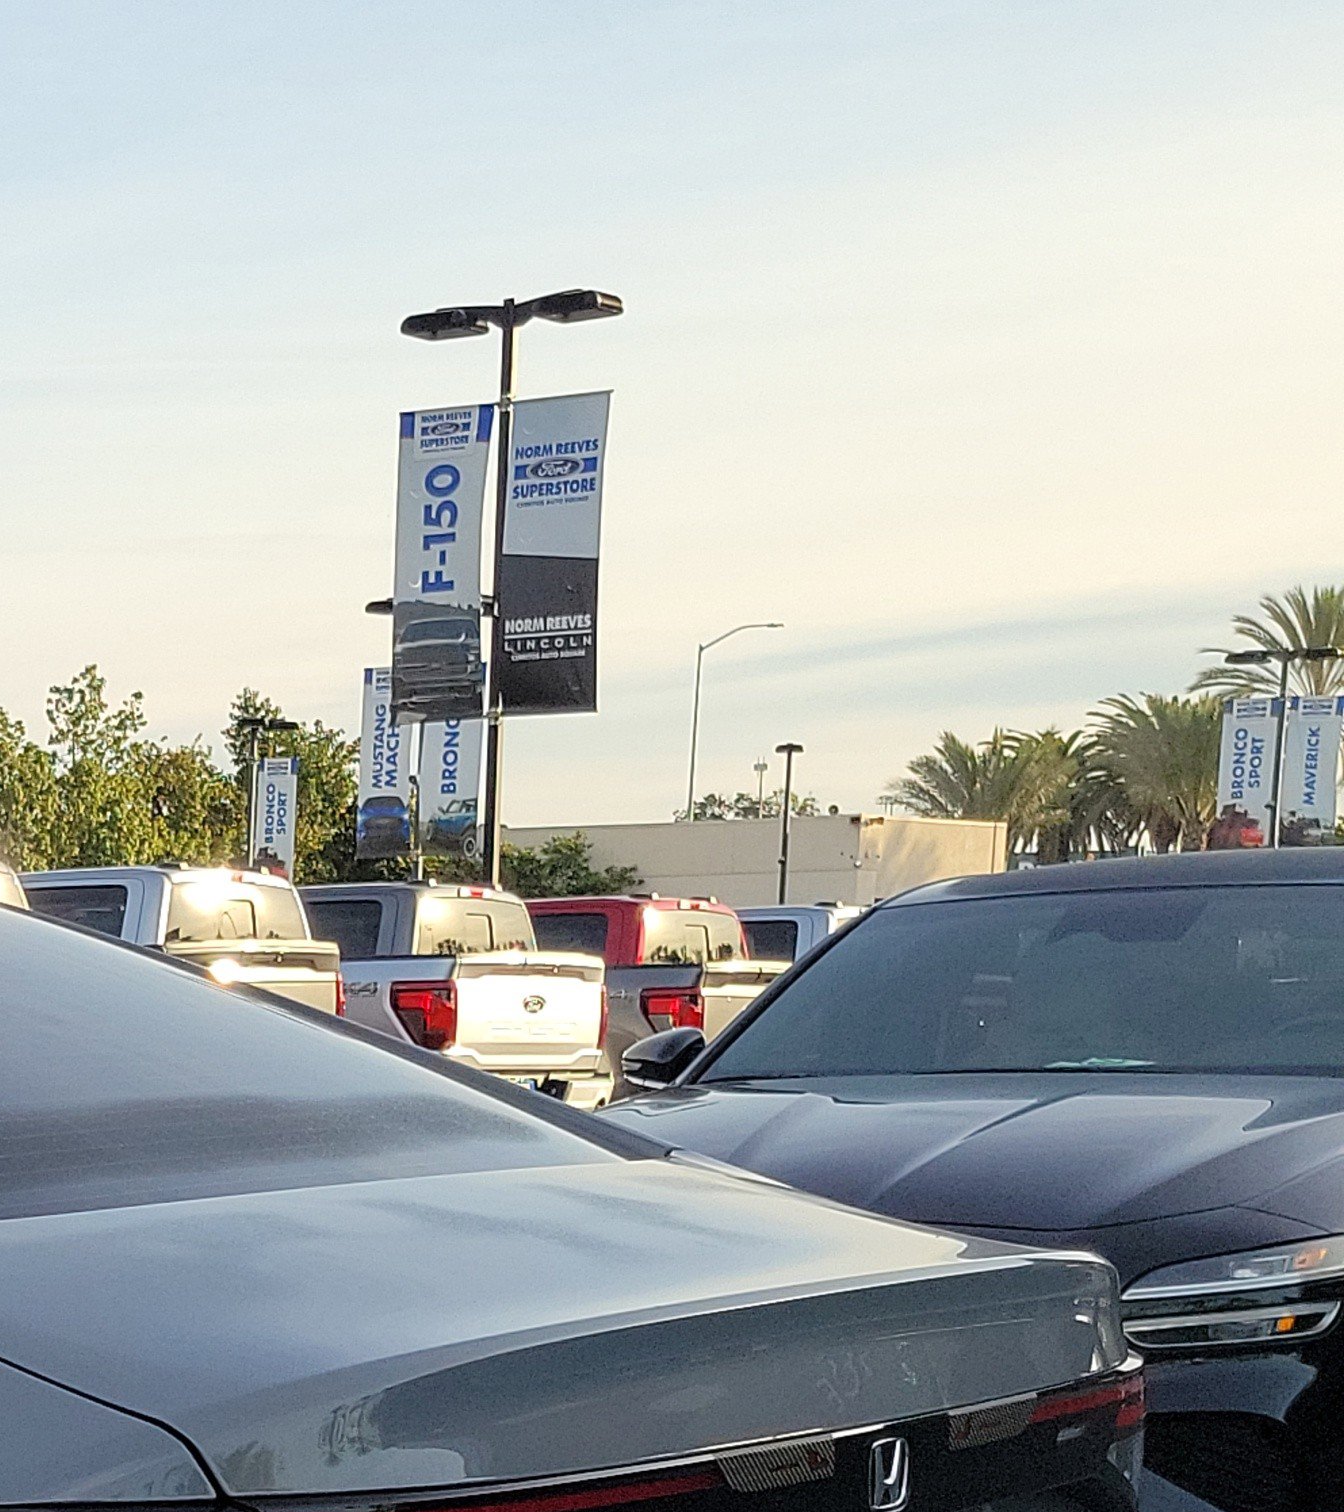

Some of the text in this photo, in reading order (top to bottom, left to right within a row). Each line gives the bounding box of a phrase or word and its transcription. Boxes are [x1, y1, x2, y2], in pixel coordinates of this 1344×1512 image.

[515, 438, 599, 460] NORM REEVES
[538, 460, 572, 477] Ford
[512, 477, 596, 500] SUPERSTORE
[421, 464, 461, 593] F-150
[504, 635, 592, 652] LINCOLN
[505, 614, 591, 633] NORM REEVES
[371, 704, 387, 788] MUSTANG
[1231, 728, 1249, 799] BRONCO
[1248, 737, 1265, 788] SPORT
[1303, 727, 1320, 805] MAVERICK
[265, 783, 275, 843] BRONCO
[276, 791, 287, 835] SPORT
